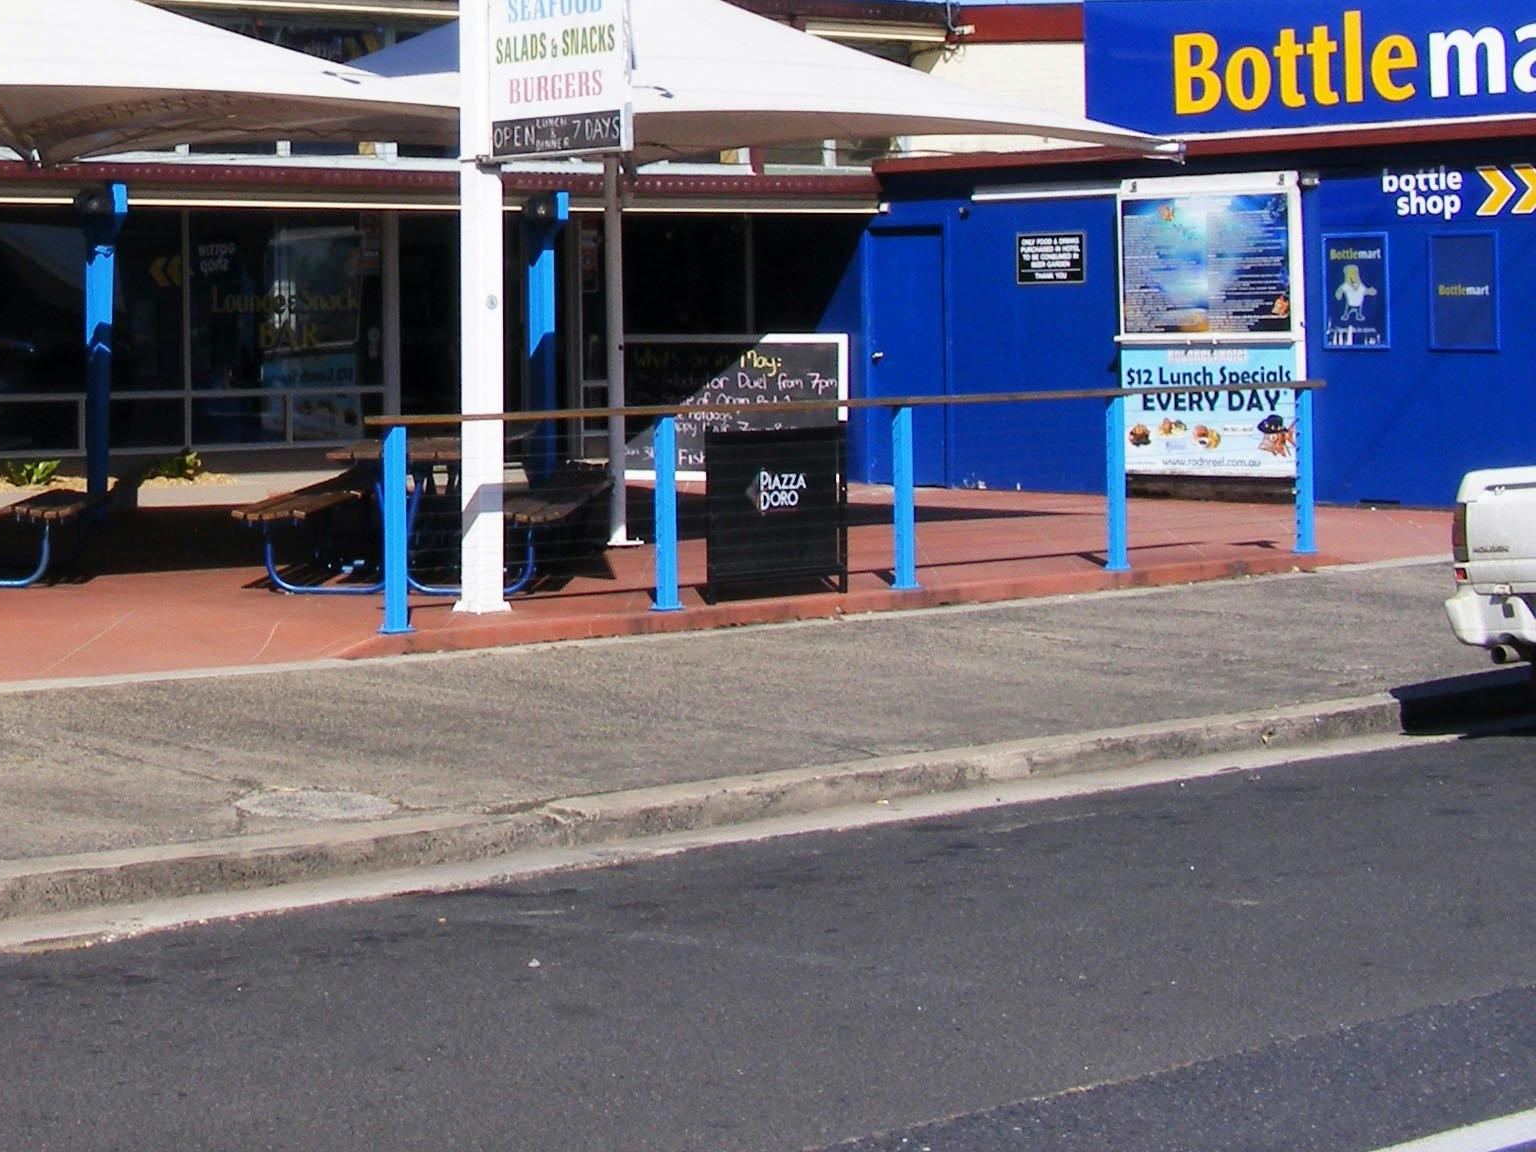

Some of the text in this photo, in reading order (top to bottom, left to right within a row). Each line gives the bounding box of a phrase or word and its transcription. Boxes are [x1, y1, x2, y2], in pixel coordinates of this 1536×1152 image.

[496, 23, 615, 65] SALADS & SNACKS
[509, 70, 603, 104] BURGERS
[536, 117, 567, 128] LUNCH
[572, 116, 620, 141] 7 DAYS
[494, 125, 536, 148] OPEN
[536, 137, 570, 151] DINNER
[1382, 165, 1463, 193] bottle
[1397, 189, 1461, 220] shop
[1036, 237, 1052, 246] FOOD
[1330, 248, 1382, 260] Bottlemart
[1034, 272, 1068, 280] THANK YOU
[1438, 284, 1490, 296] Bottlemart
[210, 286, 286, 317] Lounge
[297, 286, 360, 312] Snack
[258, 322, 320, 352] BAR
[740, 350, 782, 377] May:
[777, 373, 803, 389] from
[807, 373, 837, 395] 7pm
[1127, 365, 1291, 387] $12 Lunch Specials
[1142, 389, 1281, 411] EVERY DAY
[1162, 456, 1261, 468] www.rodnreel.com.au
[760, 471, 806, 490] PIAZZA
